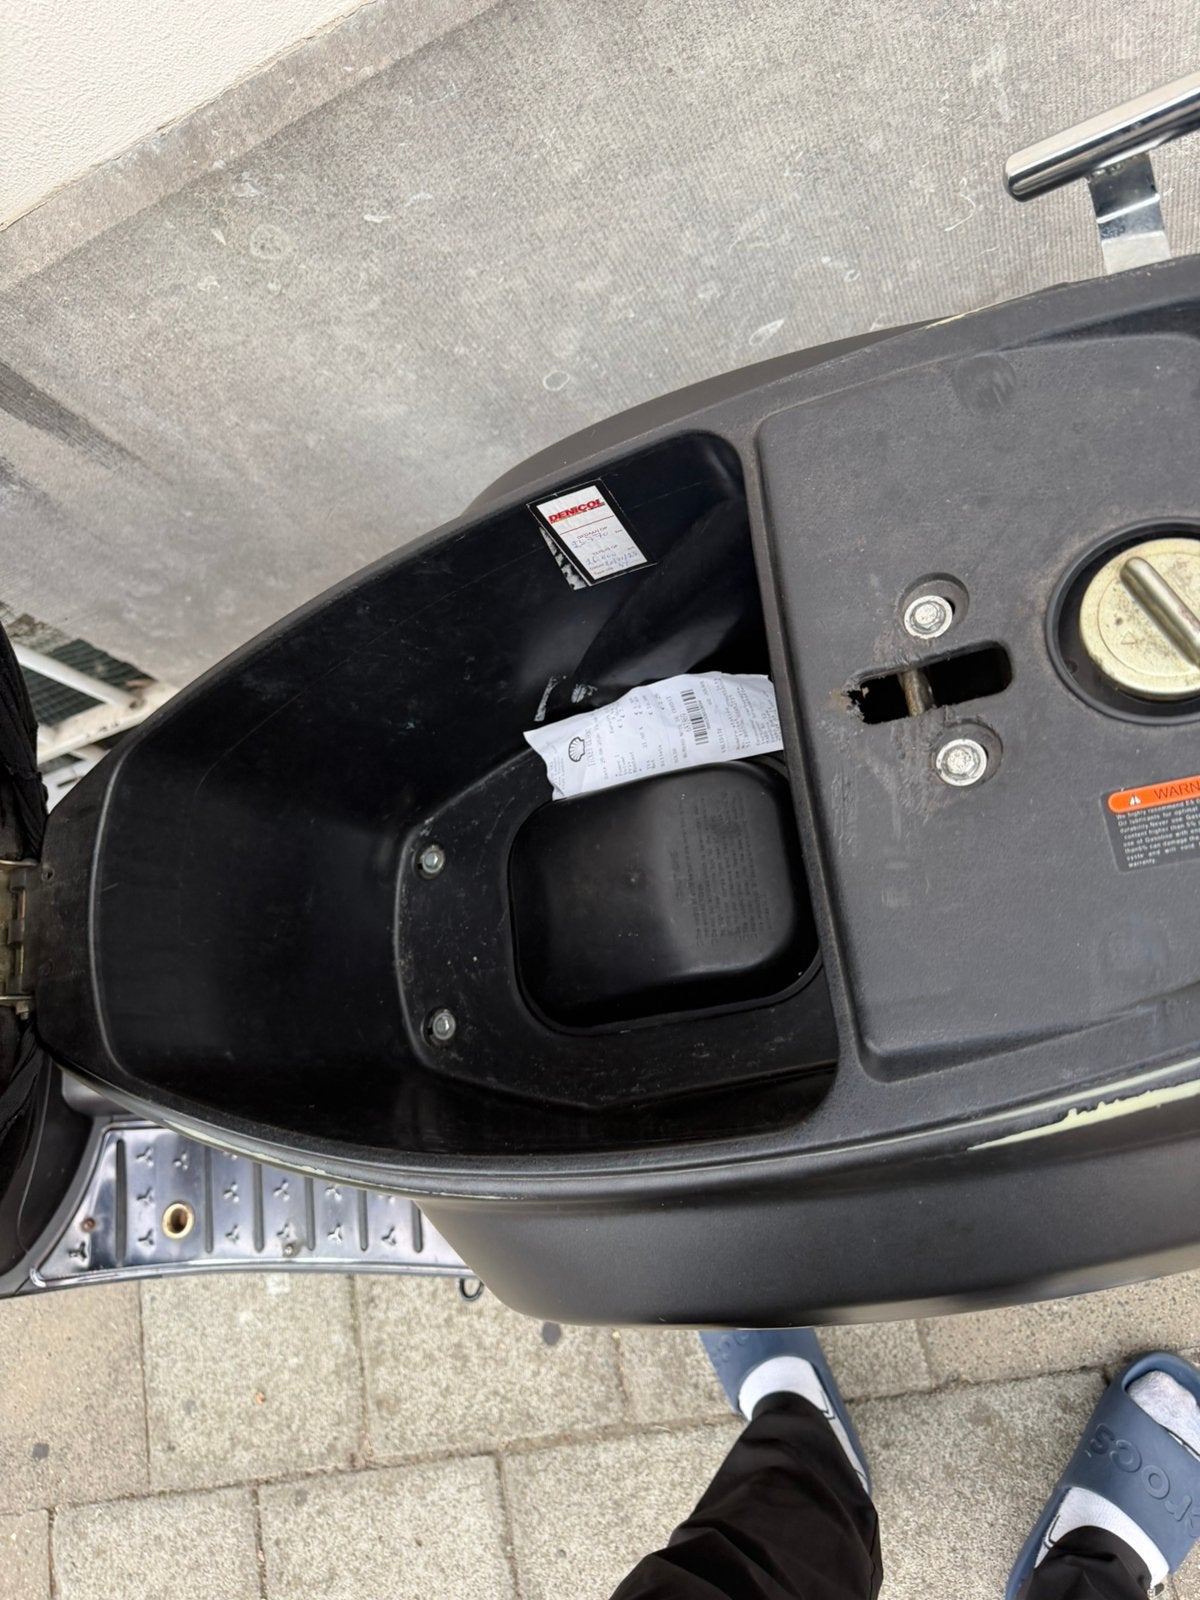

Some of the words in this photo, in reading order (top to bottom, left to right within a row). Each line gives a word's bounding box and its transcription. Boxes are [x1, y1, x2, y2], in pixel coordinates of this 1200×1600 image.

[548, 498, 605, 524] DENICOL
[1154, 780, 1200, 799] WARN
[1148, 802, 1184, 813] recommend
[1174, 807, 1198, 816] optimal
[1170, 822, 1185, 830] than
[1145, 833, 1173, 843] Gasoline
[1162, 838, 1187, 847] damage
